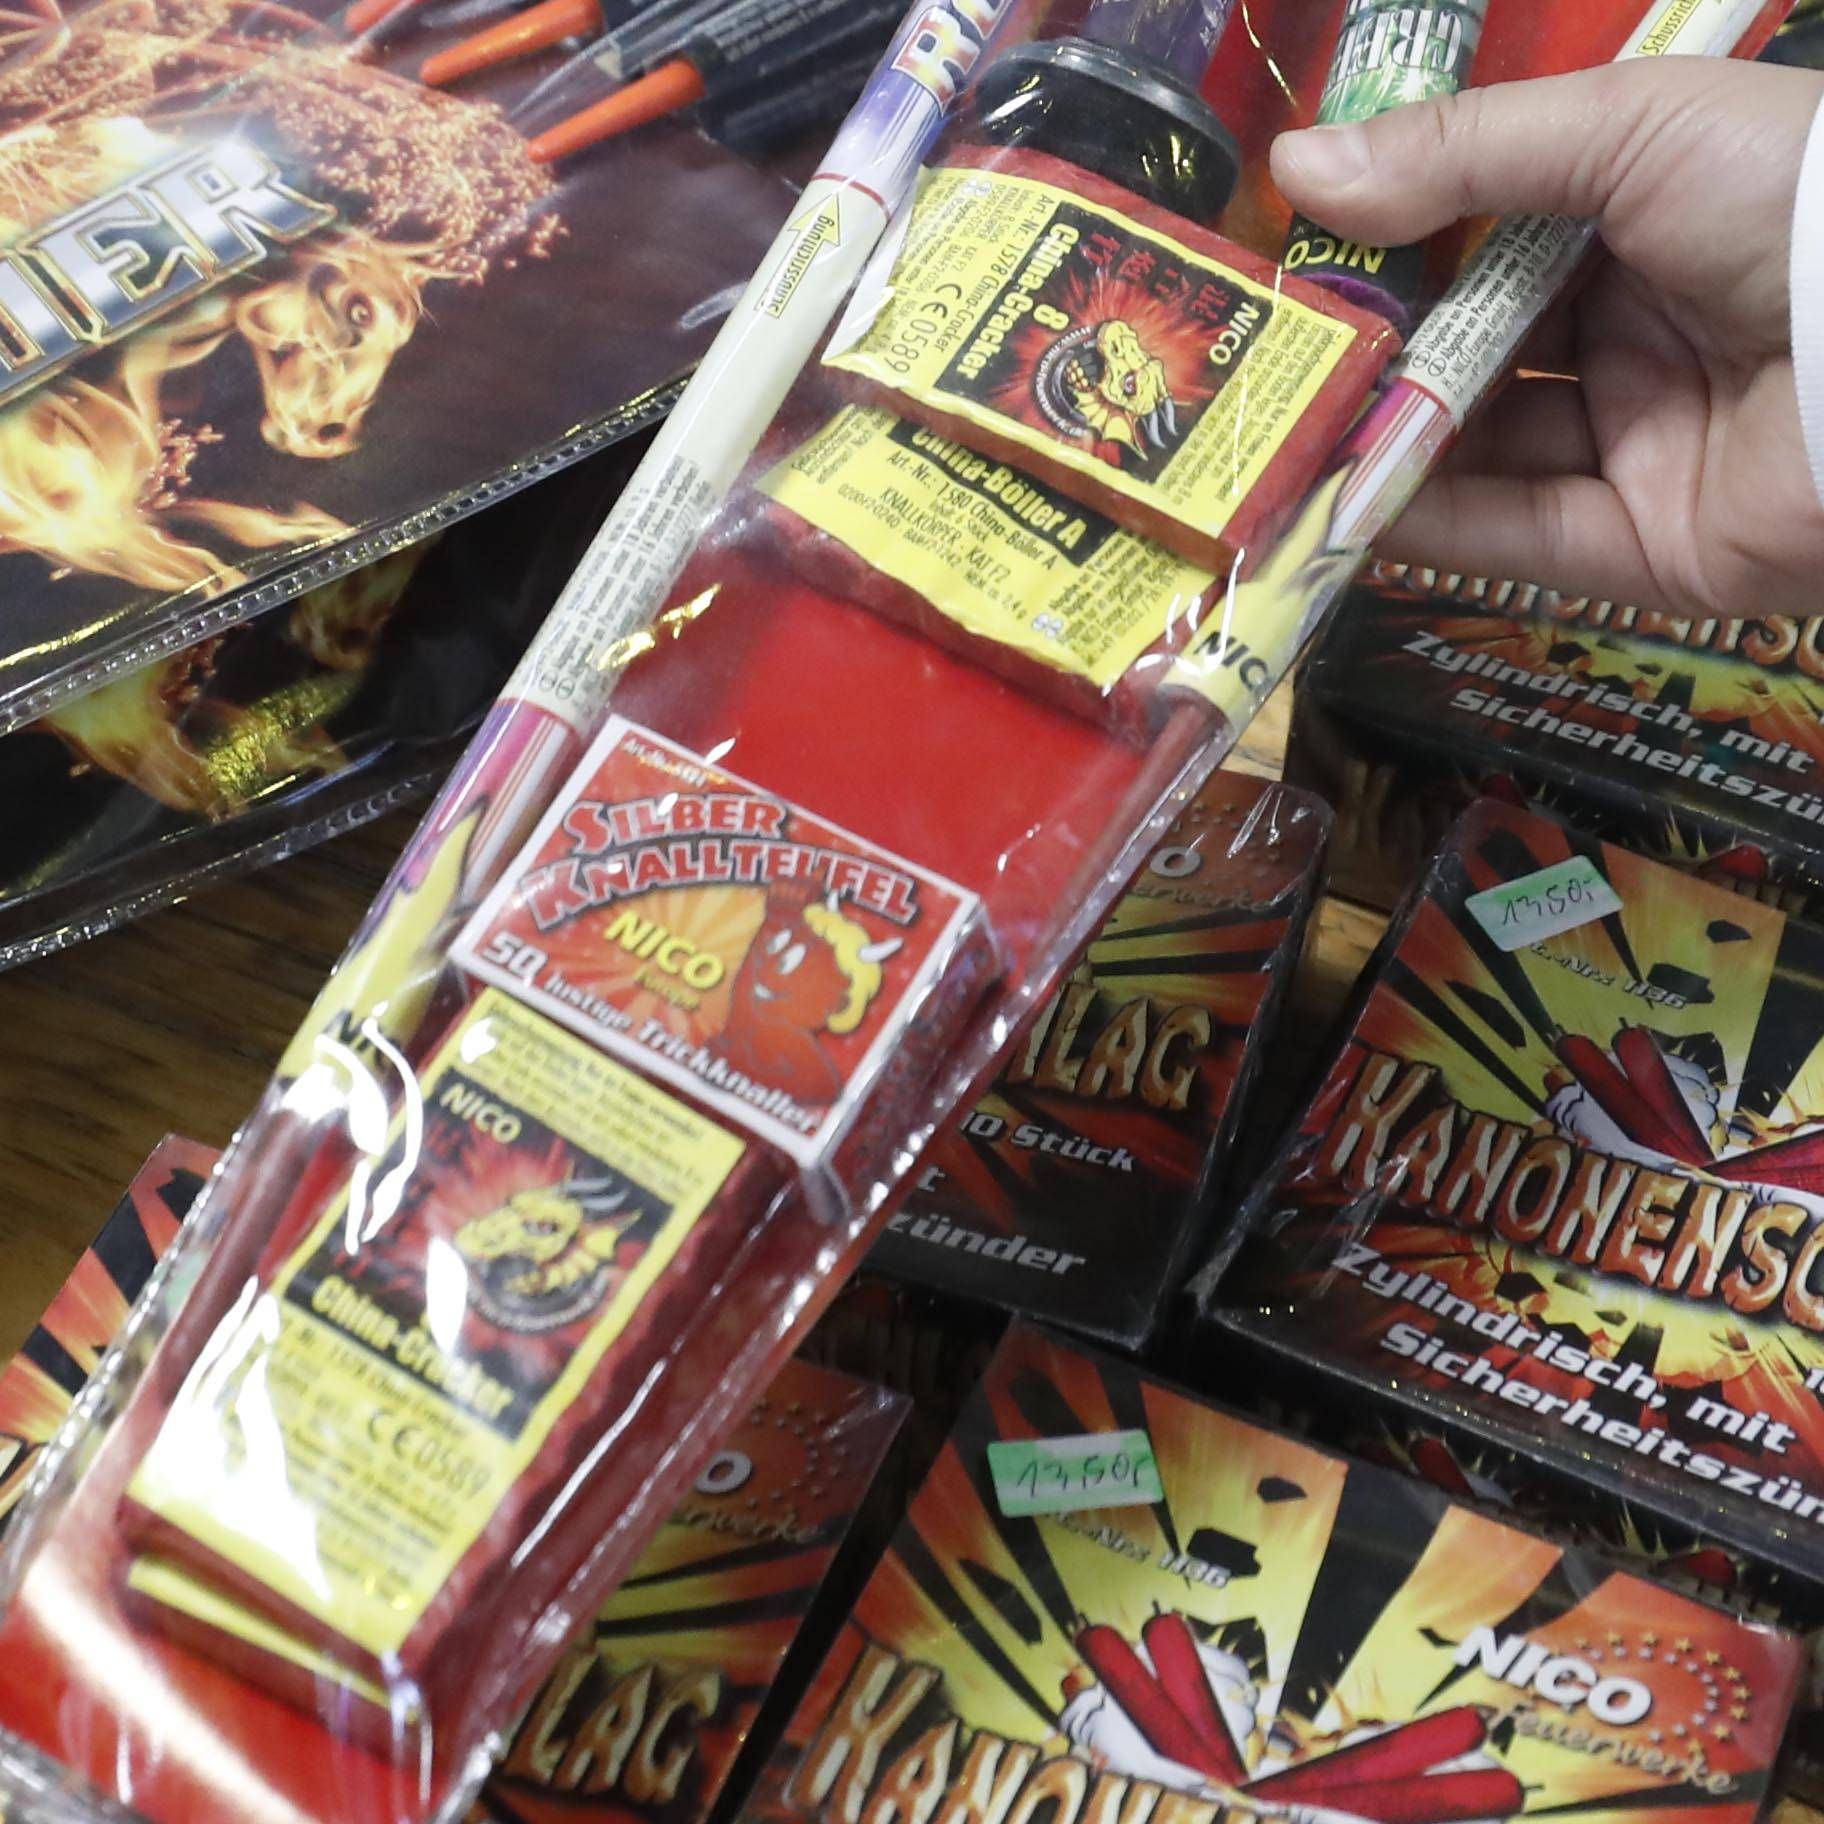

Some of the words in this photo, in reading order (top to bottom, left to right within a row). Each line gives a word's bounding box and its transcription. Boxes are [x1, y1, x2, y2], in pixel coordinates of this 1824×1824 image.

[1011, 193, 1055, 243] Art.-Nr.:
[759, 211, 835, 312] Schussrichtung
[989, 242, 1022, 277] 1578
[1283, 236, 1384, 278] NICO
[931, 274, 1001, 354] China-Cracker
[954, 219, 1081, 381] China-Cracker
[1030, 300, 1071, 333] 8
[1205, 300, 1261, 368] NICO
[1423, 319, 1458, 354] Abgabe
[1455, 270, 1493, 310] Personen
[1439, 326, 1473, 361] Abgabe
[1470, 277, 1507, 317] Personen
[880, 313, 939, 376] 0589
[1465, 324, 1494, 357] Europe
[876, 483, 964, 549] KNALLKÖRPER
[884, 445, 941, 492] Art.-Nr.:
[935, 477, 974, 513] 1580
[964, 499, 1048, 563] China-Böller
[1056, 520, 1086, 551] A
[1400, 628, 1704, 740] Zylindrisch,
[1725, 719, 1815, 778] mit
[563, 792, 786, 858] SILBER
[524, 866, 929, 930] KNALLTEUFEL
[601, 904, 729, 997] NICO
[1622, 973, 1689, 1011] 1136
[479, 926, 548, 985] 50
[540, 968, 637, 1037] lustige
[634, 1015, 822, 1138] Trickknaller
[435, 1077, 528, 1148] NICO
[1012, 1126, 1138, 1173] Stück
[1330, 1240, 1668, 1410] Zylindrisch,
[1689, 1392, 1798, 1458] mit
[408, 1429, 497, 1506] 0589
[1158, 1547, 1233, 1591] 1136
[1452, 1622, 1652, 1727] NICO
[1480, 1698, 1741, 1798] Feuerwerke
